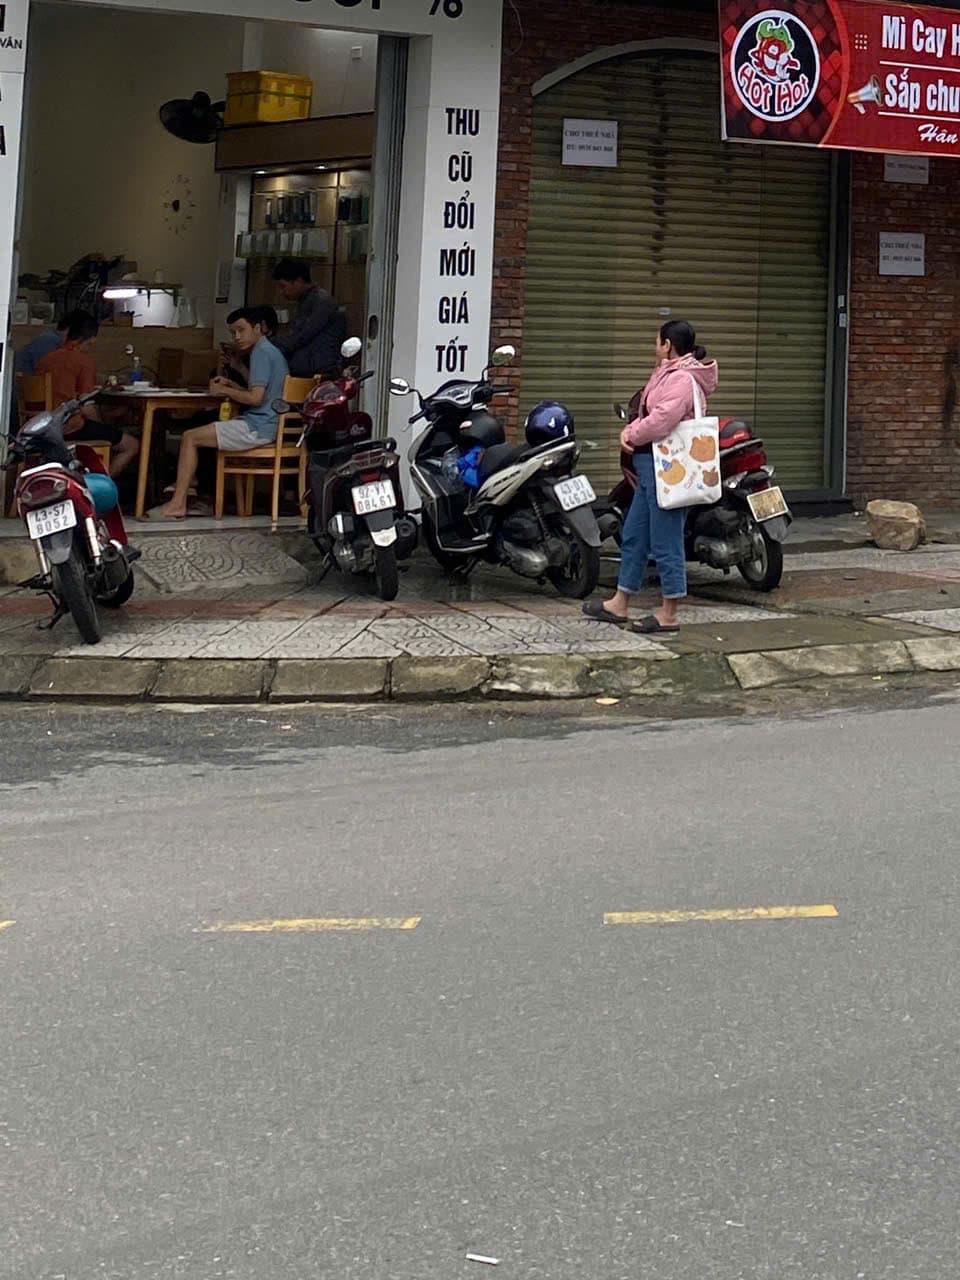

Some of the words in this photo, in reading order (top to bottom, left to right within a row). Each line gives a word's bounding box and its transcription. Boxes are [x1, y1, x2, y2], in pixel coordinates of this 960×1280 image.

[0, 36, 22, 49] VÂN
[882, 15, 905, 50] Mì
[912, 19, 947, 58] Cay
[884, 68, 921, 112] Sắp
[445, 107, 480, 136] THU
[918, 123, 958, 143] Hân
[448, 151, 473, 182] CŨ
[443, 191, 475, 230] ĐỔI
[439, 242, 475, 276] MỚI
[438, 291, 469, 324] GIÁ
[435, 336, 469, 373] TỐT
